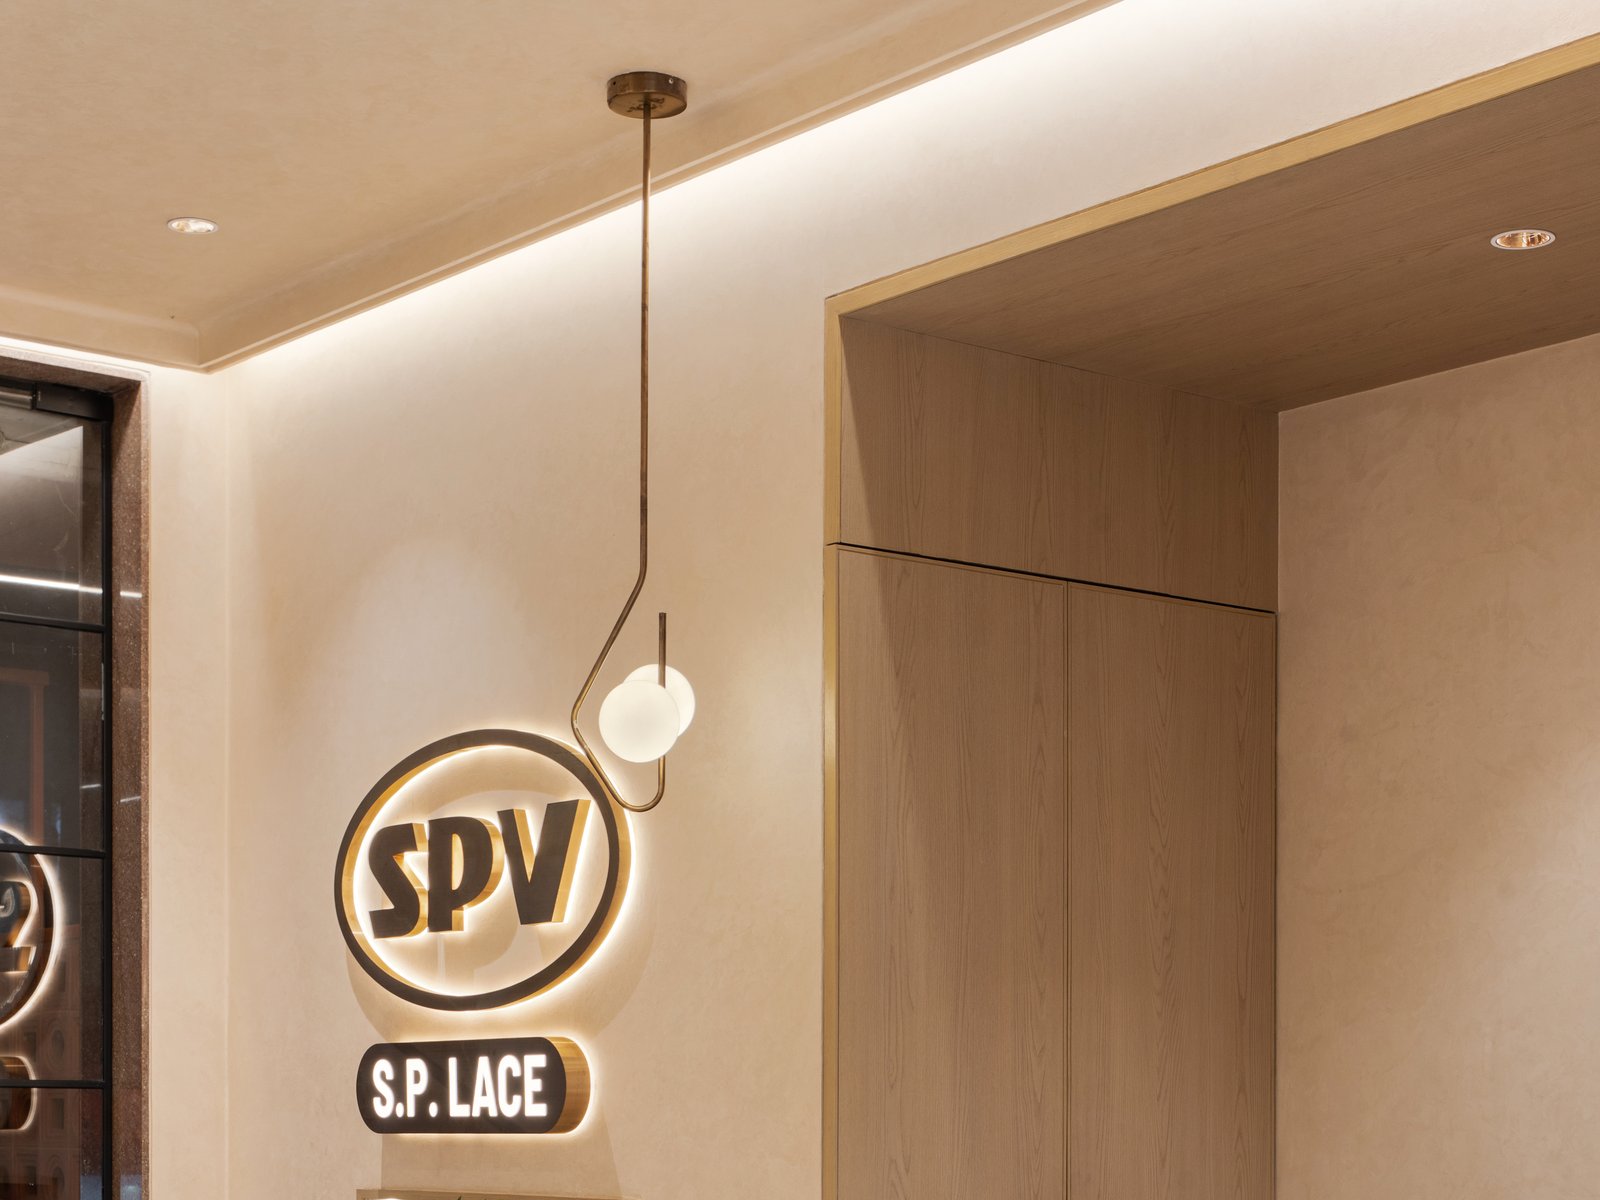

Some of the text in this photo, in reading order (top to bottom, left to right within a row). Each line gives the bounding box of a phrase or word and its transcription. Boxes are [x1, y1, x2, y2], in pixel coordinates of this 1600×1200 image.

[368, 799, 586, 939] SPV
[373, 1054, 547, 1118] S.P. LACE
